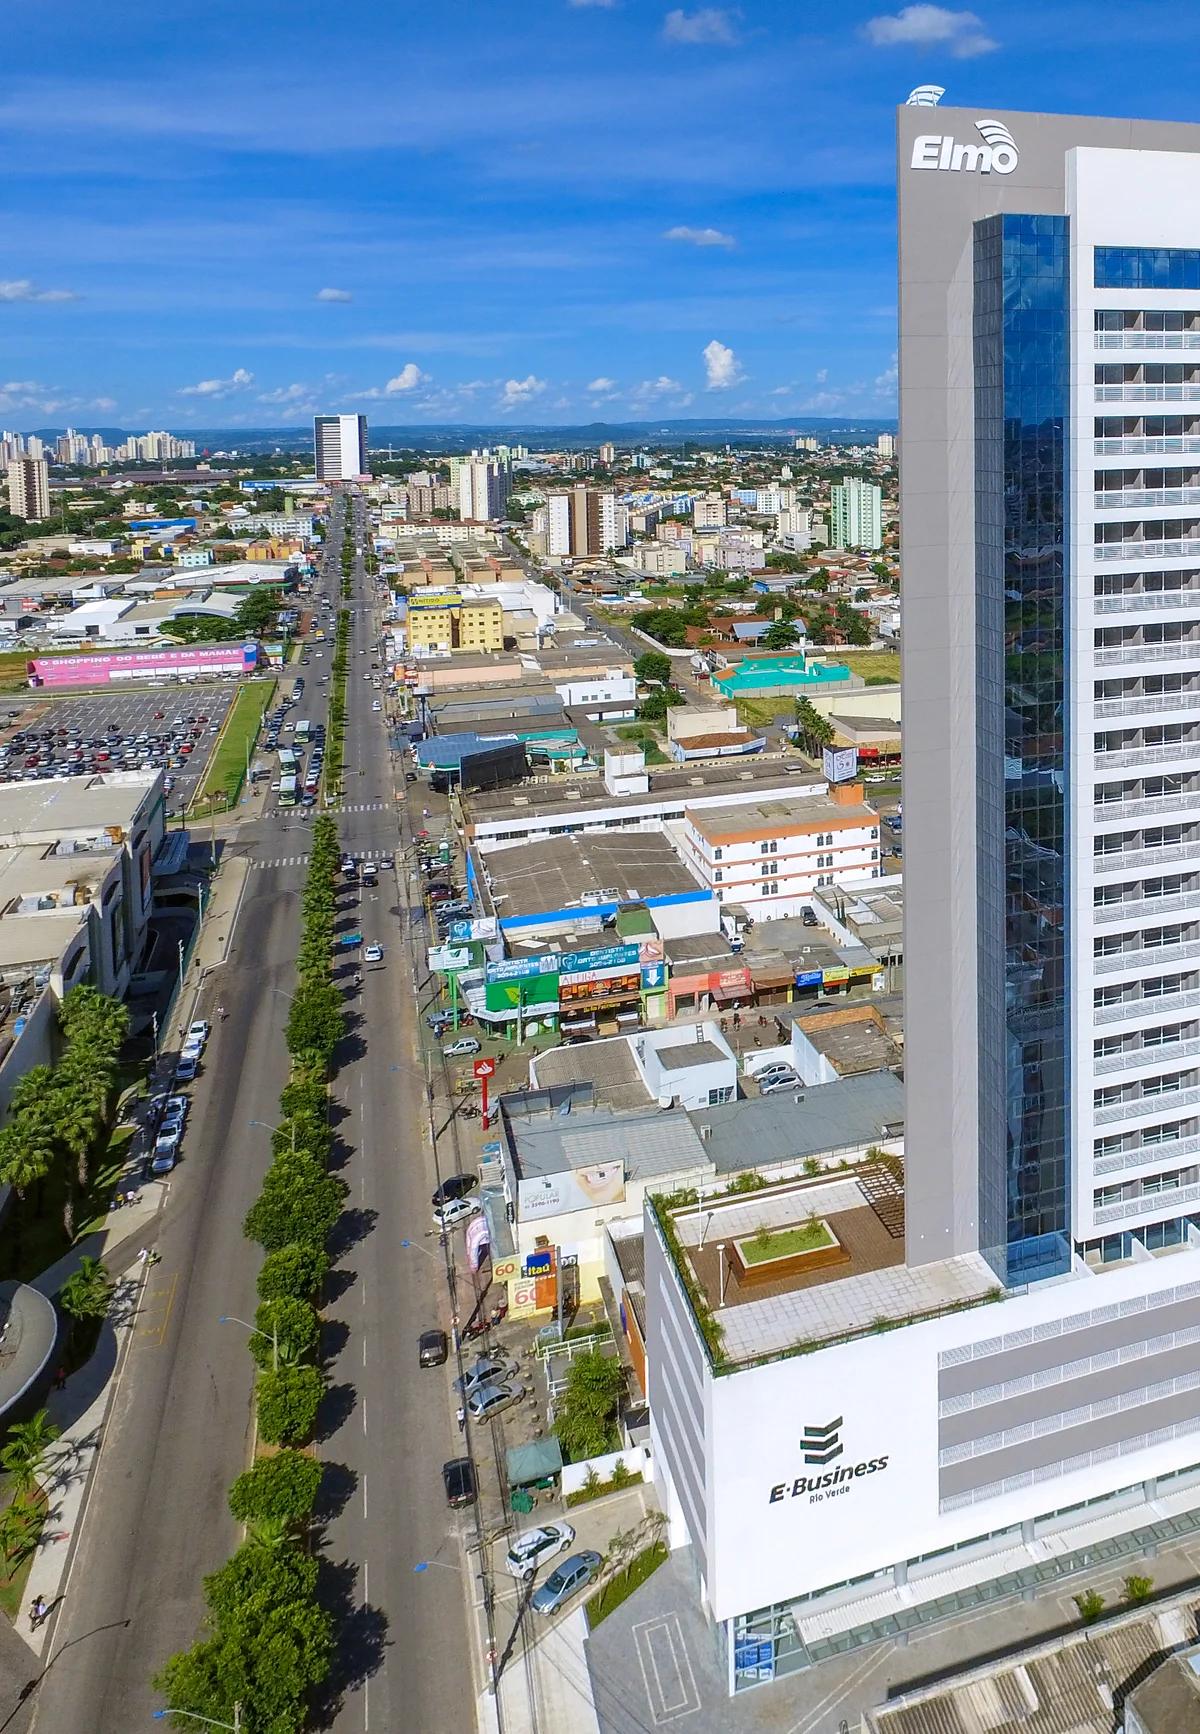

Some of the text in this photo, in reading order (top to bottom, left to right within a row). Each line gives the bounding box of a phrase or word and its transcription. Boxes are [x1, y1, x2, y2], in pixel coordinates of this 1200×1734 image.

[910, 134, 1019, 175] Elmo
[52, 656, 111, 665] SHOPPING
[495, 1263, 515, 1276] 60
[528, 1263, 550, 1276] Itaú
[809, 1485, 851, 1505] Rio Verde
